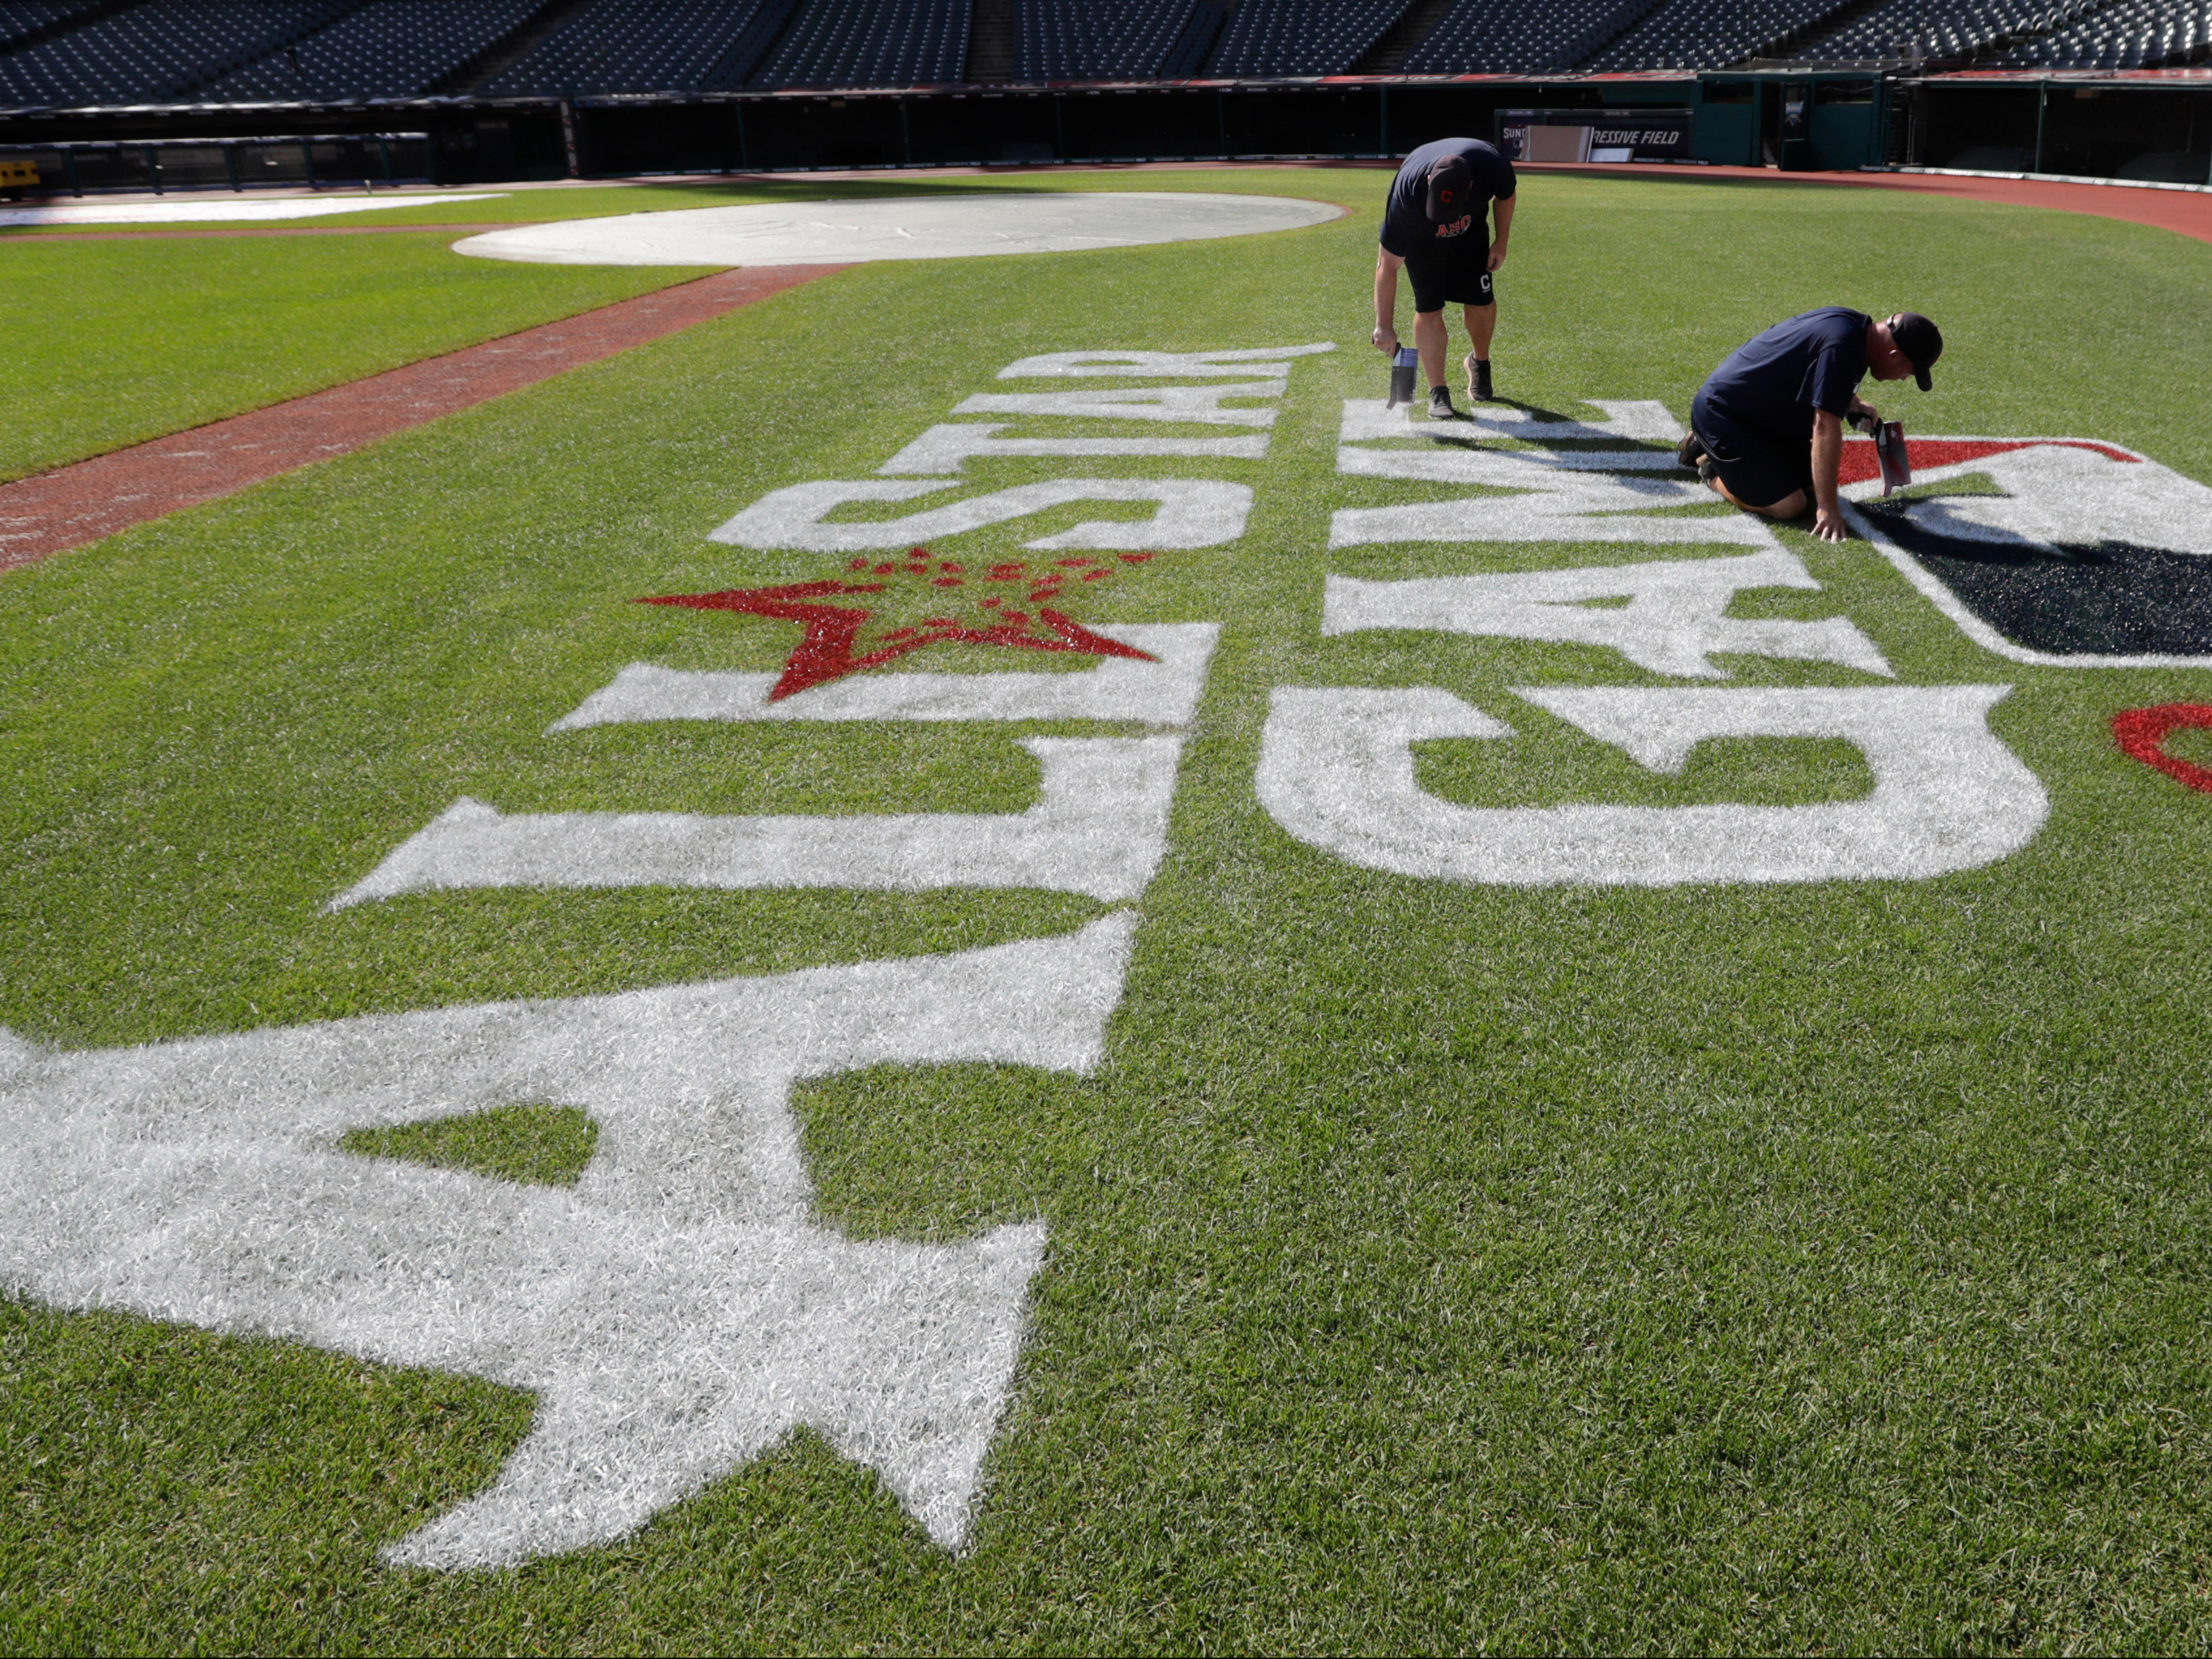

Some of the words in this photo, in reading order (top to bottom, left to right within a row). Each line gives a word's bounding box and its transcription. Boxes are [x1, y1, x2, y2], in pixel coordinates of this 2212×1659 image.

[1640, 131, 1680, 145] FIELD
[1441, 190, 1452, 203] C
[1480, 274, 1490, 290] C
[1254, 398, 2049, 886] GAME
[0, 623, 1219, 1570] ALL
[708, 342, 1335, 551] STAR
